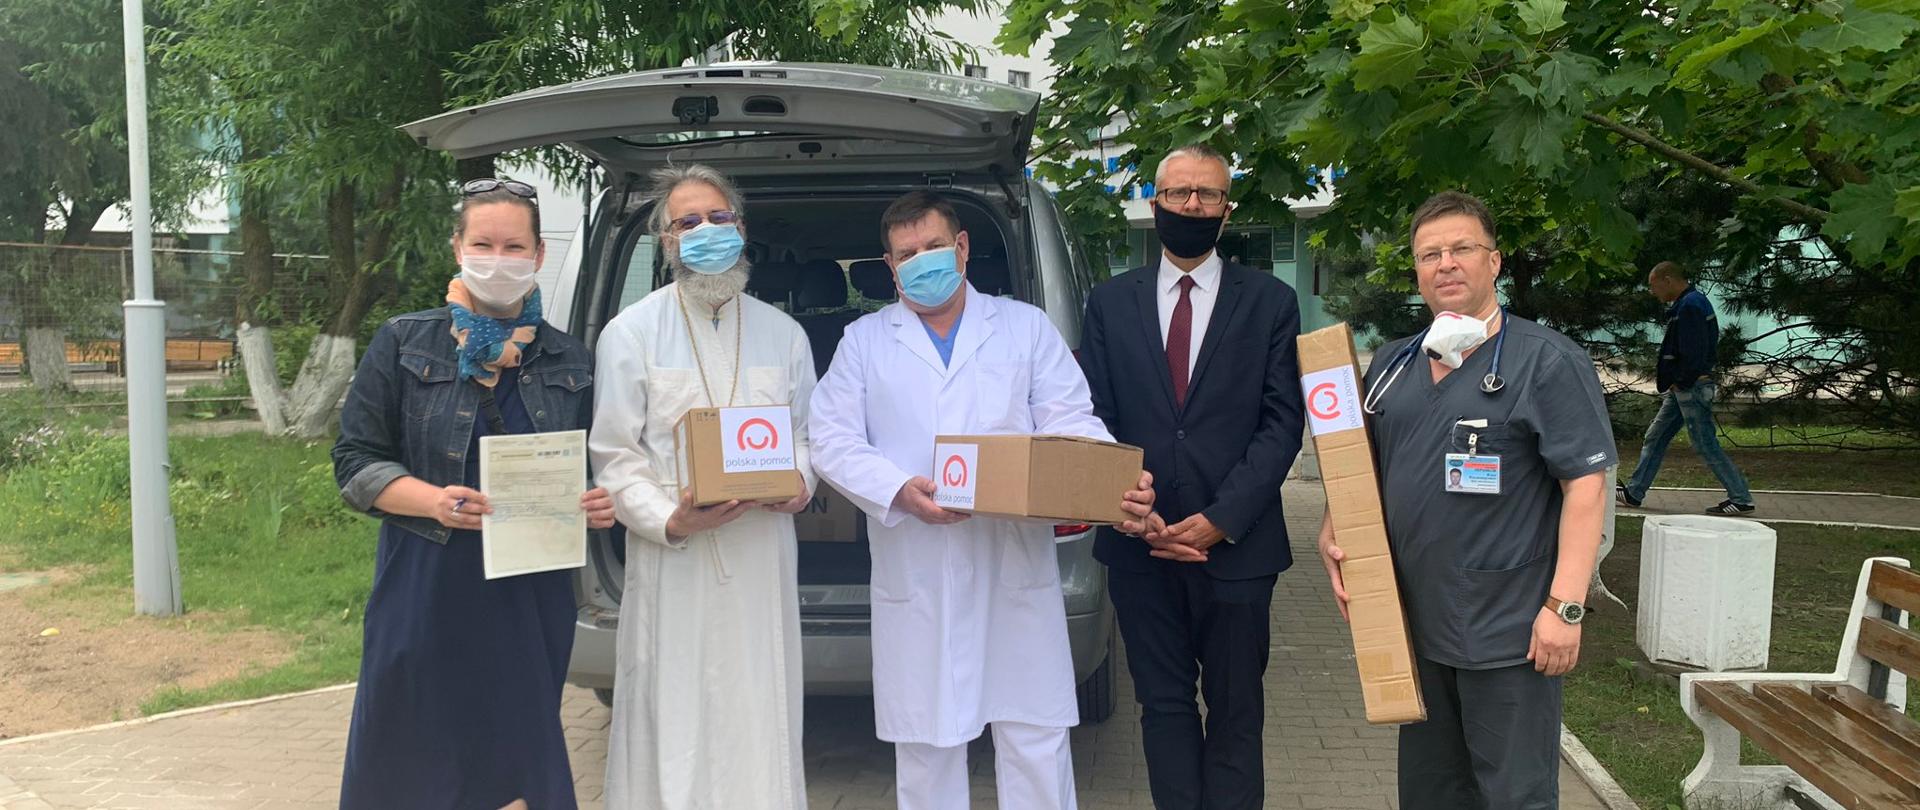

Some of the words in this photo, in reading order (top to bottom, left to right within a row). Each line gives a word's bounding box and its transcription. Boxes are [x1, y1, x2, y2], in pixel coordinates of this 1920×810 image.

[1343, 367, 1353, 397] pomoc
[1347, 399, 1359, 427] polska
[725, 456, 757, 468] polska
[760, 455, 792, 466] pomoc
[953, 494, 973, 504] pomoc
